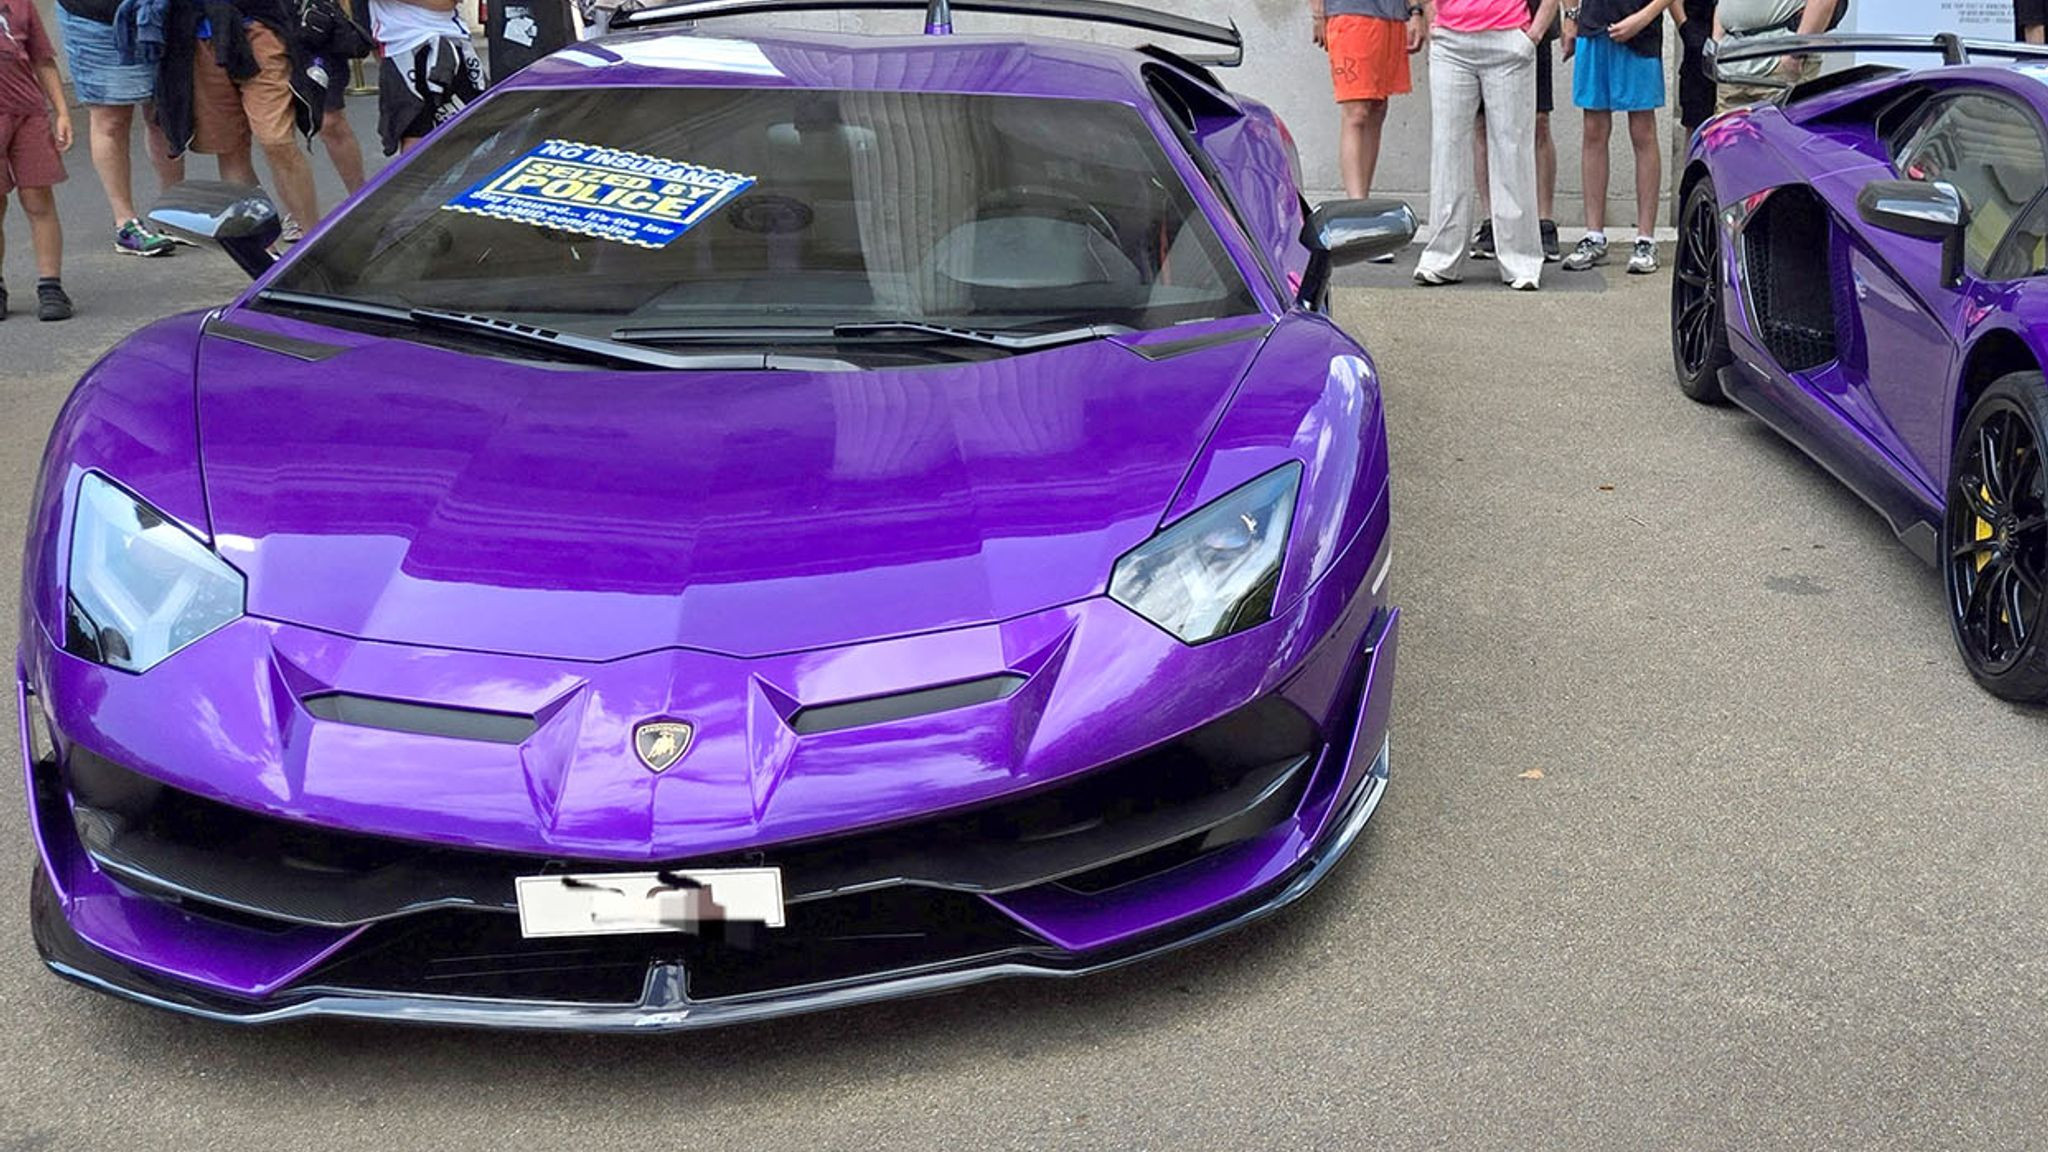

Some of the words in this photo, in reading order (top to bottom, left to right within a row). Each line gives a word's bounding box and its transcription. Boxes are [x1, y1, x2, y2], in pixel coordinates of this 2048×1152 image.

[525, 163, 652, 190] SEIZED
[659, 182, 715, 199] BY
[539, 144, 584, 159] NO
[584, 152, 744, 191] INSURANCE
[501, 175, 697, 218] POLICE
[613, 217, 641, 229] the
[641, 223, 675, 236] law
